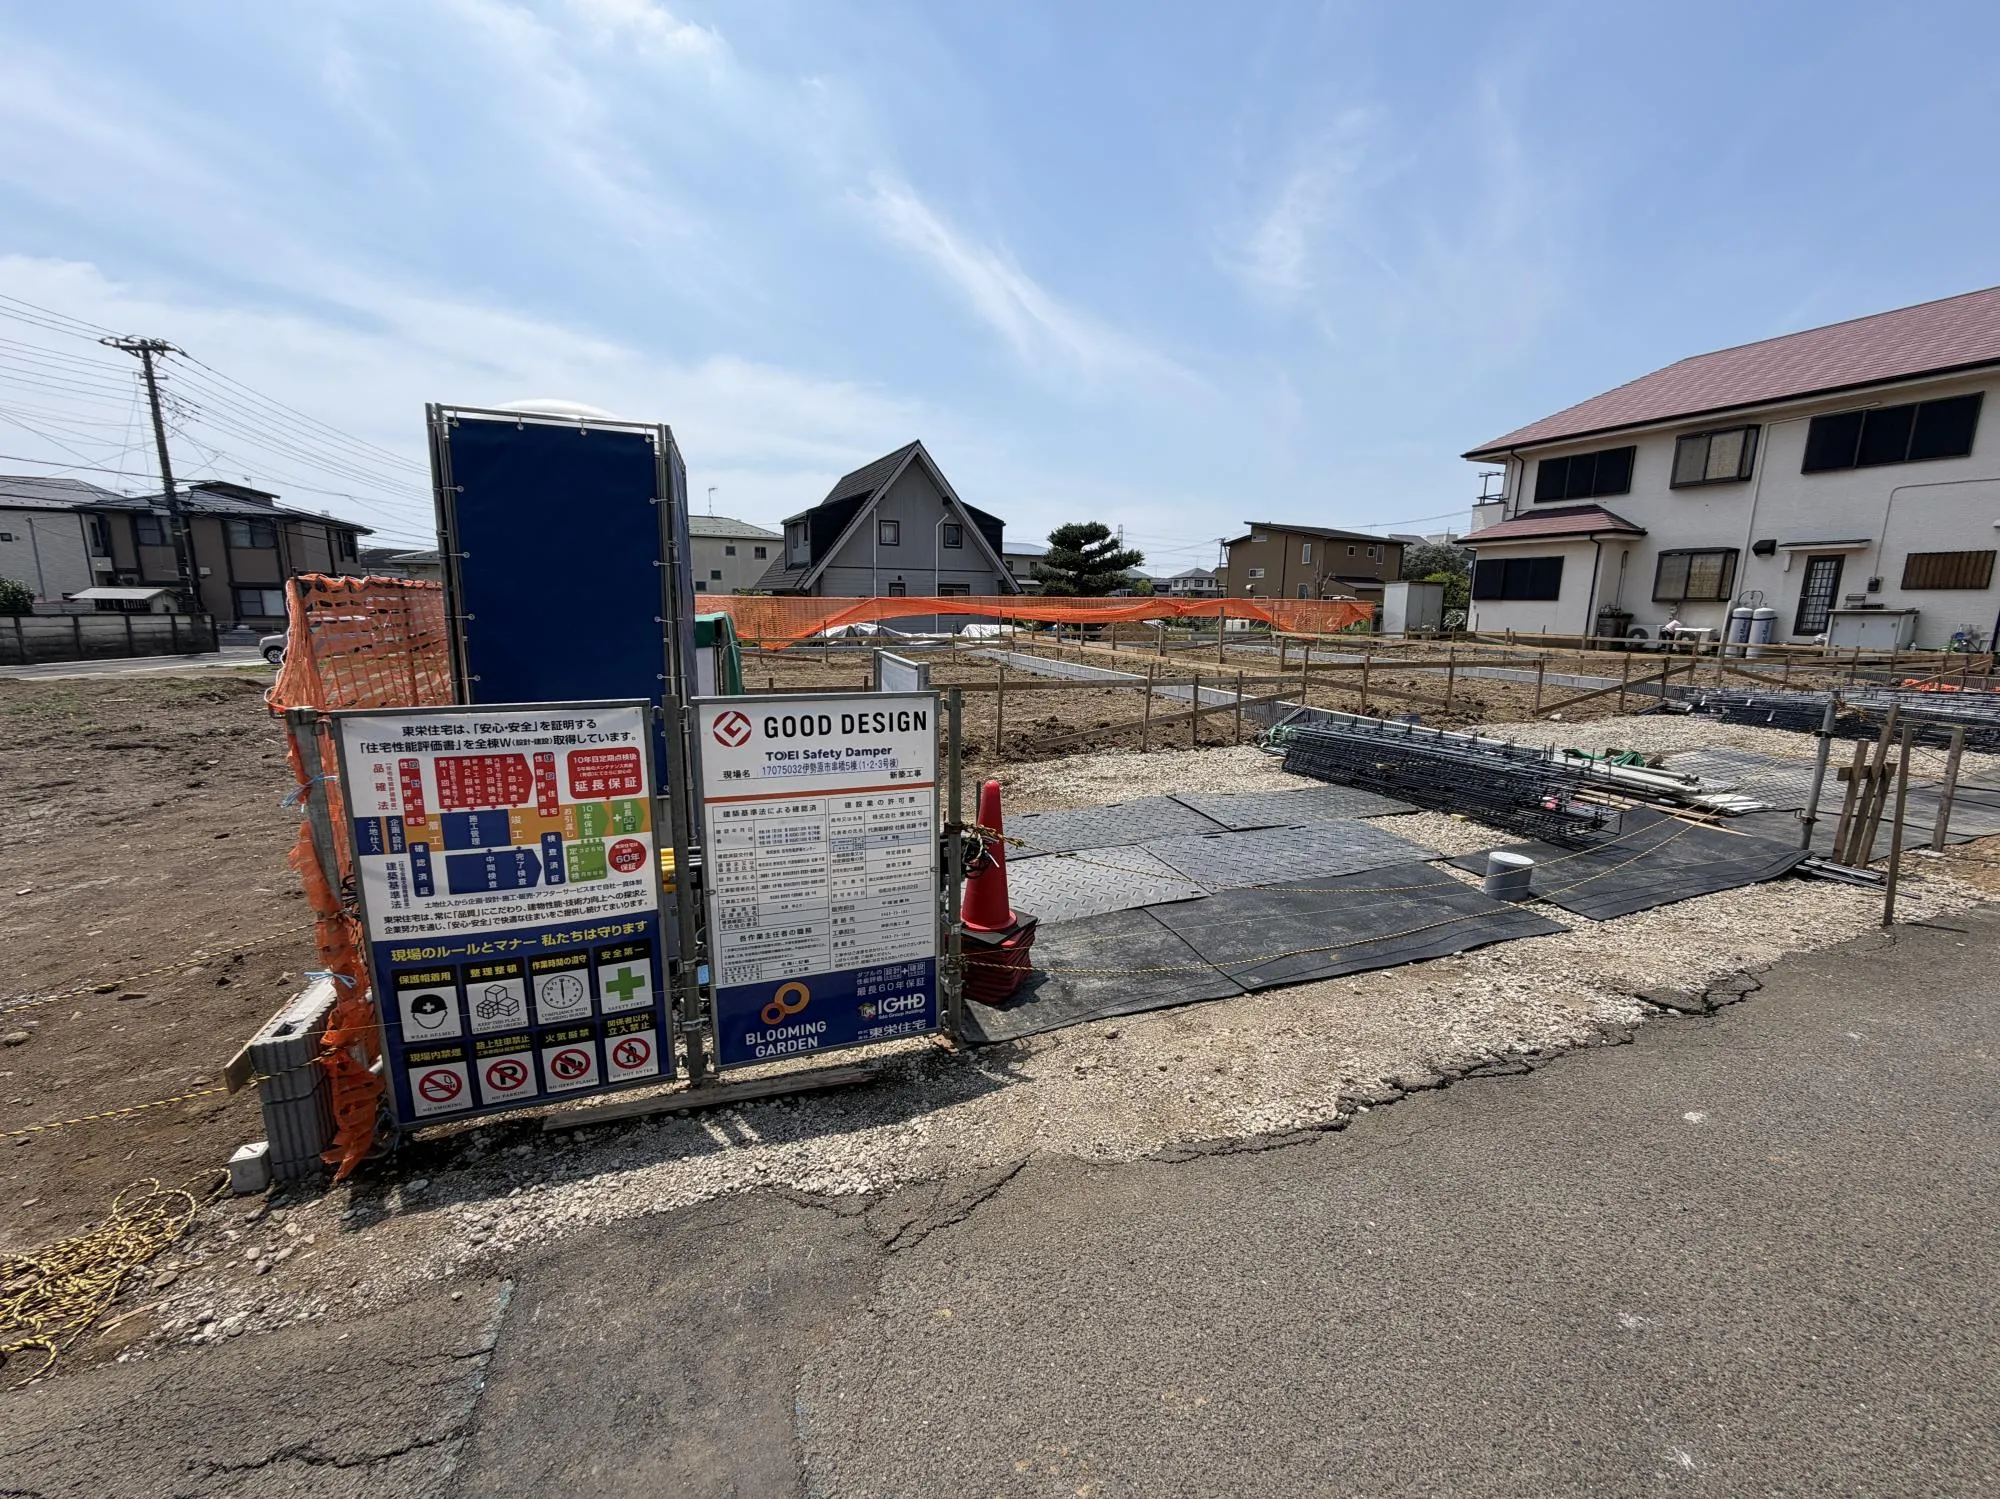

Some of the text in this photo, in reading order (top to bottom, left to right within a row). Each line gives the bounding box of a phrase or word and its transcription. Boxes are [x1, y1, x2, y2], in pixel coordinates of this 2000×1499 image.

[764, 710, 927, 739] GOOD DESIGN
[803, 750, 841, 762] Safety
[845, 747, 893, 759] Damper
[723, 770, 751, 780] 現場名
[889, 770, 923, 780] 新築工事
[575, 777, 638, 793] 延長保証
[723, 804, 817, 818] 建築基準法による確認済
[845, 796, 916, 809] 建設業の許可票
[582, 805, 593, 836] 10年保証
[368, 820, 381, 852] 土地仕入
[468, 815, 481, 846] 施工管理
[547, 835, 560, 883] 検査済証
[569, 848, 580, 879] 定期点検
[616, 853, 640, 864] 60年
[486, 856, 498, 888] 中間検査
[515, 853, 527, 886] 完了検査
[385, 861, 402, 909] 建築基準法
[391, 920, 648, 962] 現場のルールとマナー 私たちは守ります
[740, 927, 812, 942] 各作業主任者の職務
[532, 954, 587, 970] 作業時間の遵守
[601, 947, 645, 960] 安全第一
[469, 964, 518, 978] 整理整頓
[857, 977, 926, 997] 最長60年保証
[878, 993, 926, 1015] IGHD
[607, 1013, 650, 1028] 関係者以外
[608, 1021, 651, 1036] 立入禁止
[870, 1019, 927, 1038] 東栄住宅
[545, 1028, 590, 1043] 火気厳禁
[745, 1020, 827, 1046] BLOOMING
[755, 1036, 819, 1058] GARDEN
